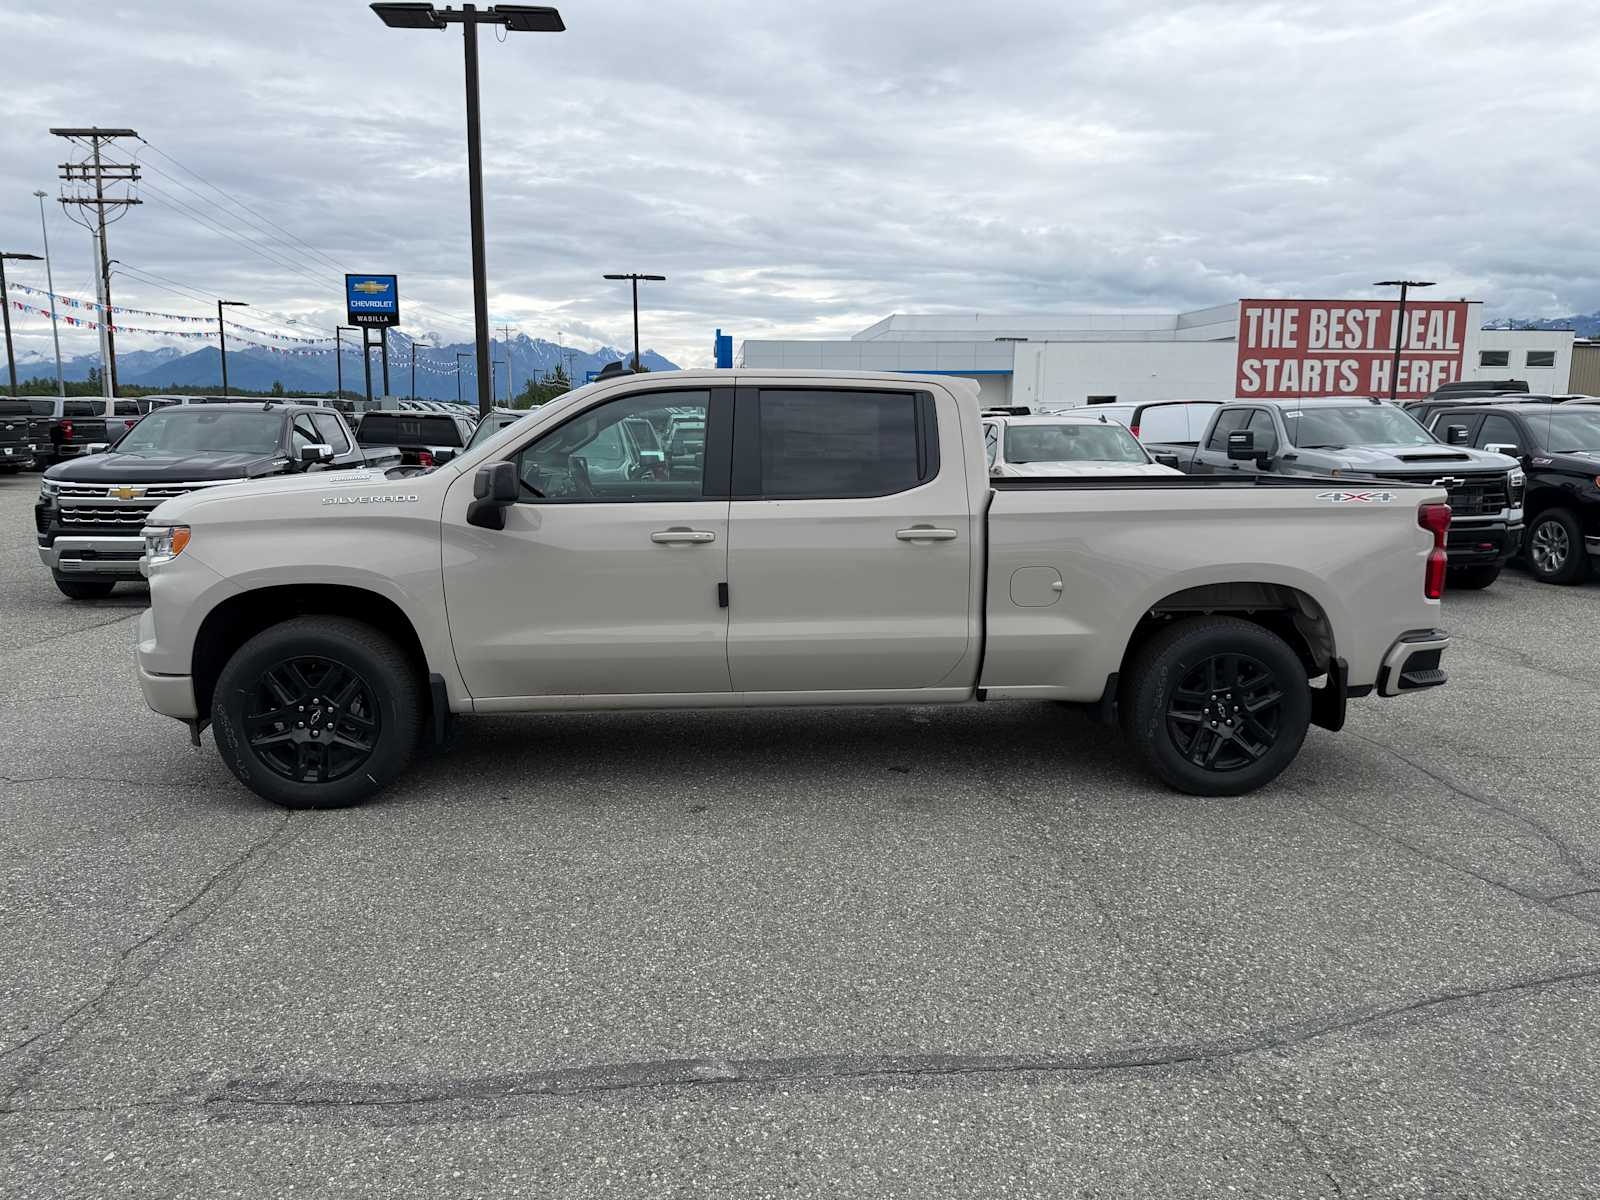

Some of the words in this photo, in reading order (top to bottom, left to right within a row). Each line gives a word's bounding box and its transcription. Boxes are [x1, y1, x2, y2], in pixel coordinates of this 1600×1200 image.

[1246, 308, 1299, 348] THE
[1308, 309, 1381, 349] BEST
[1389, 310, 1460, 349] DEAL
[1241, 359, 1360, 392] STARTS
[322, 494, 418, 505] SILVERADO
